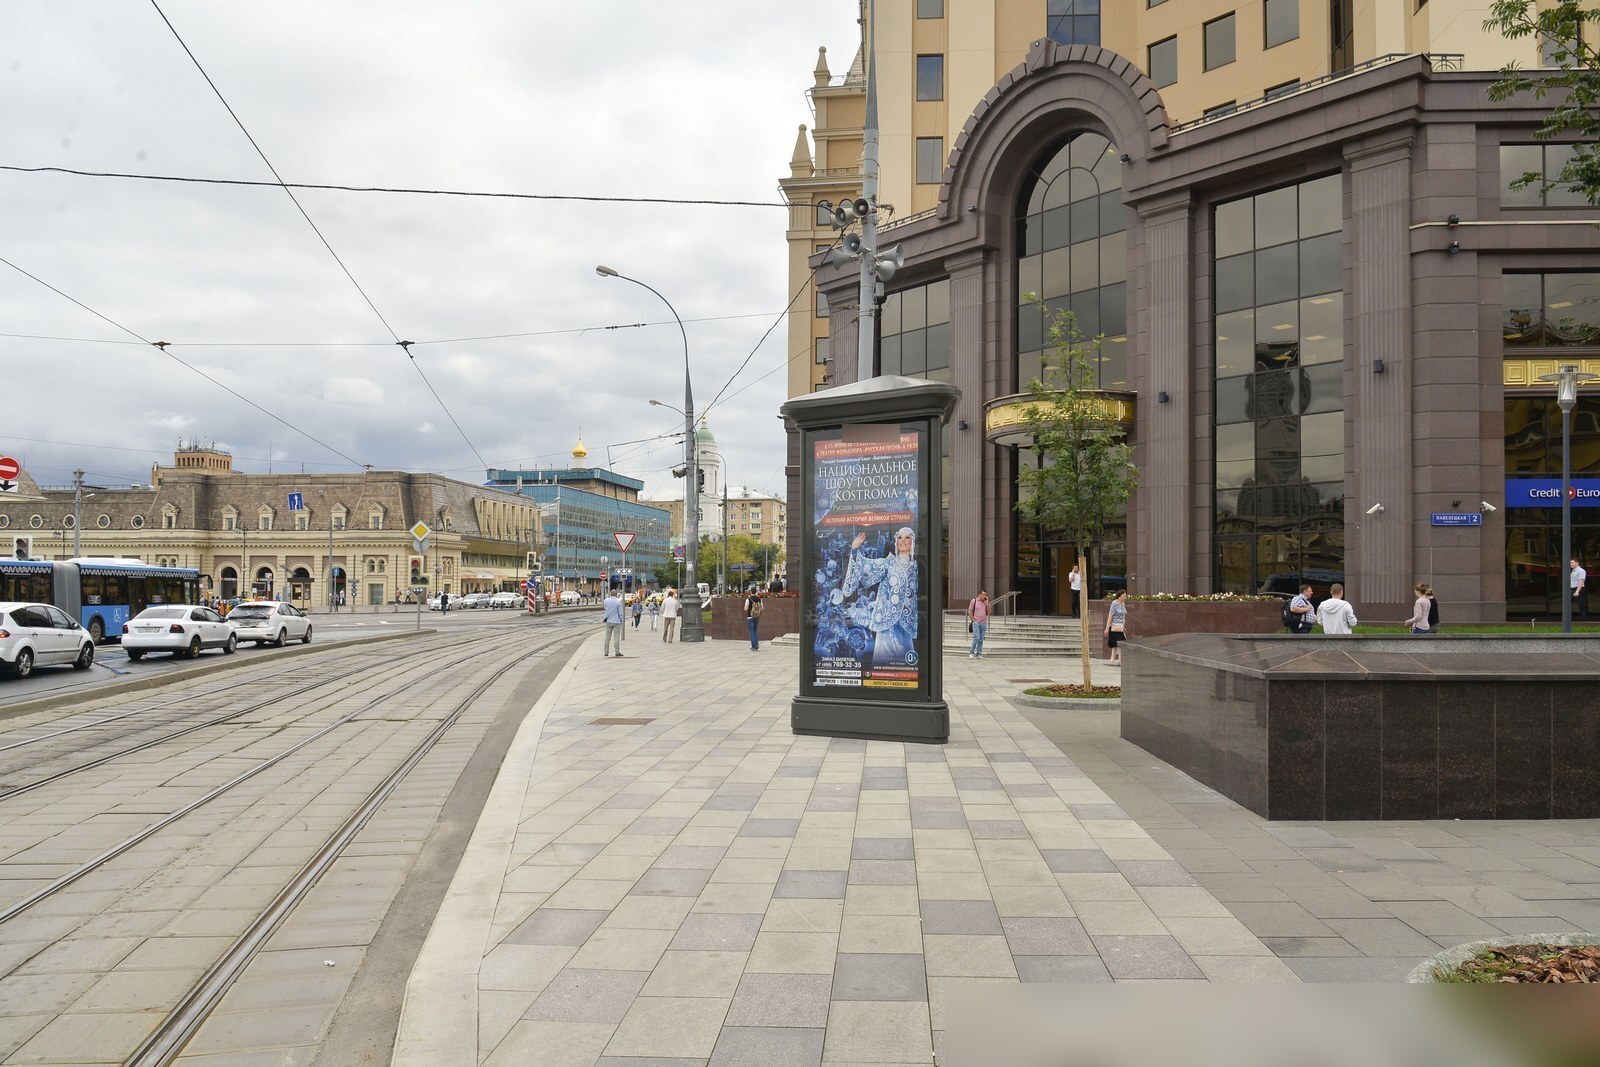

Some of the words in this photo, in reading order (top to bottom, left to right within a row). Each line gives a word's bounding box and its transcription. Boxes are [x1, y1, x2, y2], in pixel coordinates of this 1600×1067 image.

[819, 460, 917, 478] НАЦИОНАЛЬНОЕ
[826, 477, 853, 490] ШОУ
[857, 475, 909, 488] РОССИИ
[1529, 488, 1560, 498] Credit
[1472, 515, 1478, 523] 2
